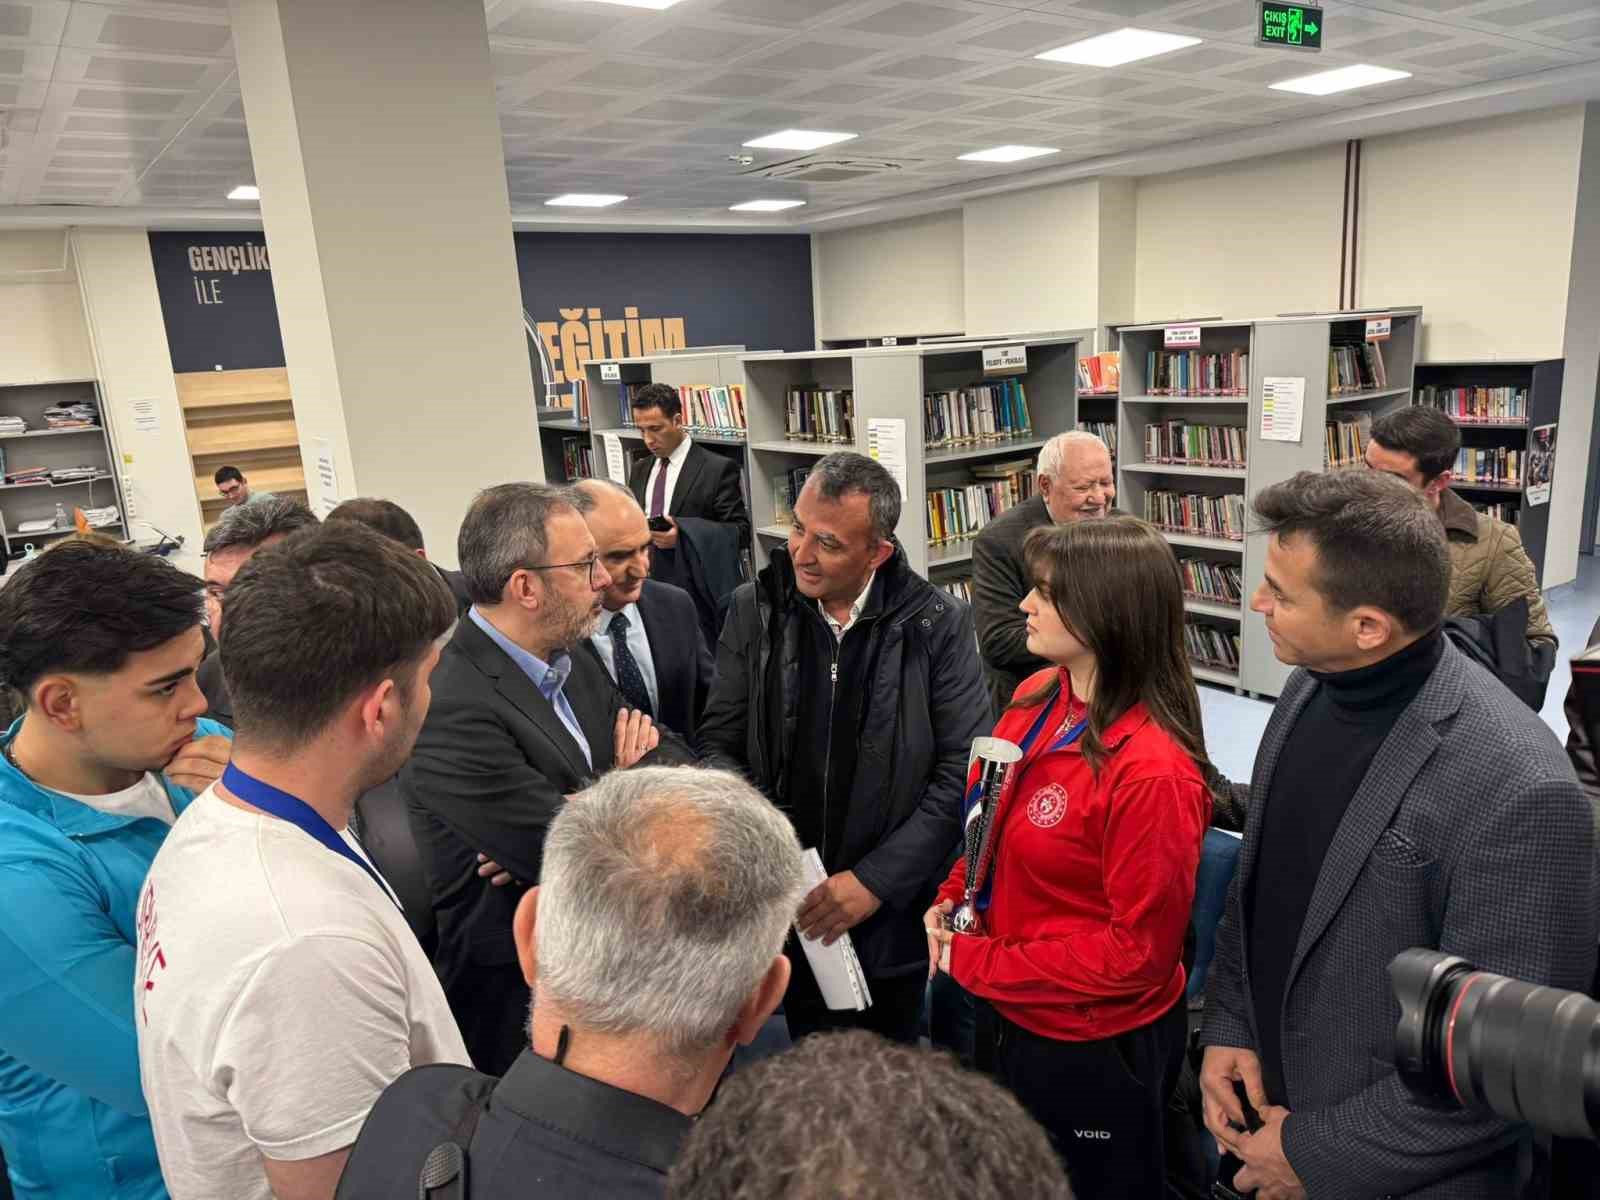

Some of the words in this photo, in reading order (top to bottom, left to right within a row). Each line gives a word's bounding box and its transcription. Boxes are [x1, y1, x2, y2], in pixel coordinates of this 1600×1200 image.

[1265, 25, 1285, 38] EXIT
[188, 242, 271, 275] GENÇLİK
[193, 276, 223, 304] İLE
[1073, 1129, 1112, 1140] VOID
